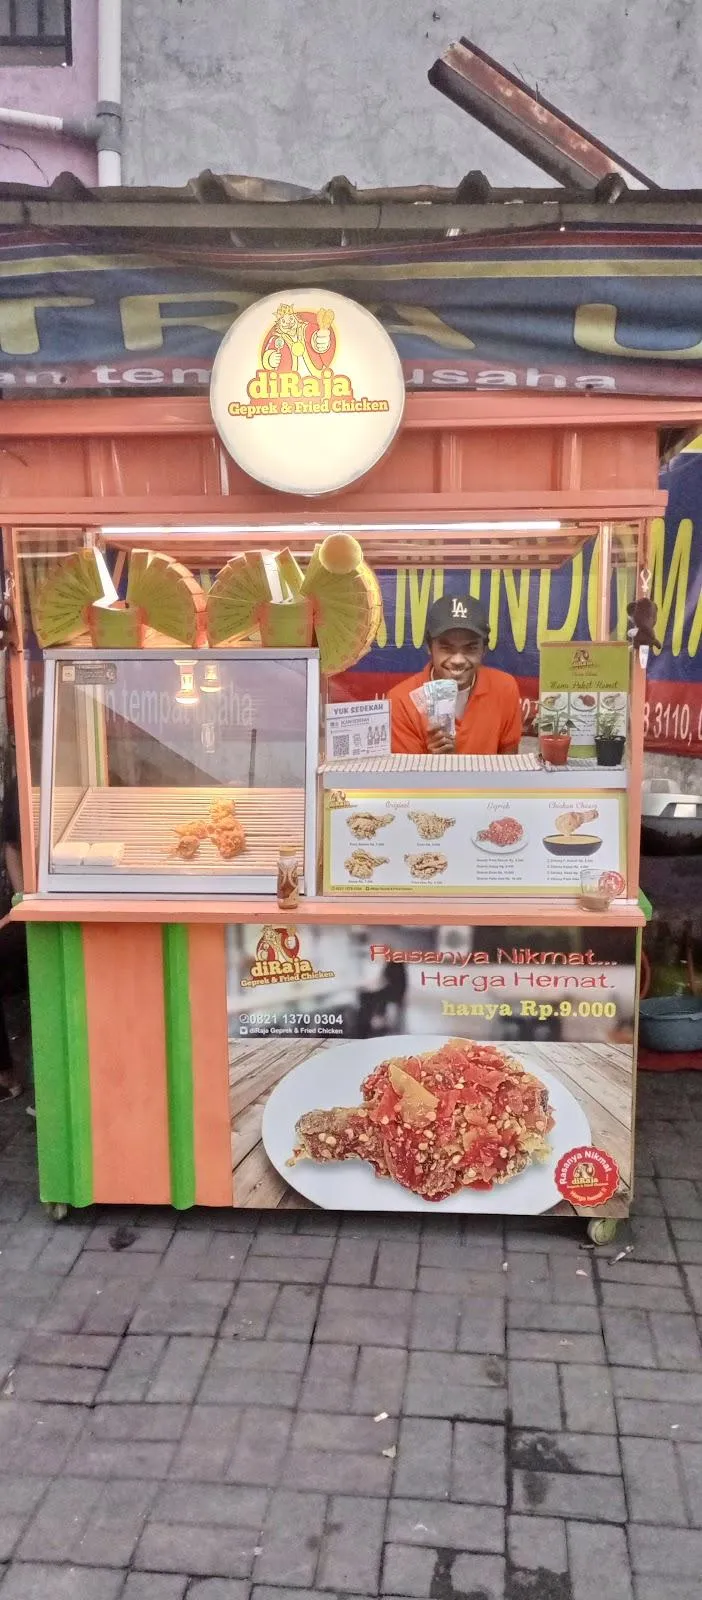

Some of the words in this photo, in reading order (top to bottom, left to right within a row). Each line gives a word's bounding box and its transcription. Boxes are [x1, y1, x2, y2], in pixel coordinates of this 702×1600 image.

[247, 367, 352, 400] diRaja
[228, 401, 278, 418] Geprek
[281, 401, 294, 414] &
[294, 399, 331, 414] Fried
[331, 397, 389, 413] Chicken
[451, 598, 467, 618] LA
[350, 703, 383, 714] SEDEKAH
[370, 943, 489, 968] Rasanya
[250, 956, 313, 977] diRaja
[240, 977, 270, 988] Geprek
[270, 976, 279, 984] &
[279, 973, 300, 983] Fried
[300, 970, 335, 981] Chicken
[420, 971, 506, 992] Harga
[514, 972, 616, 989] Hemat.
[250, 1014, 278, 1025] 0821
[282, 1014, 311, 1025] 1370
[314, 1014, 343, 1025] 0304
[441, 1001, 513, 1018] hanya
[520, 1000, 617, 1020] Rp.9.000
[249, 1027, 269, 1035] diRaja
[270, 1027, 293, 1035] Geprek
